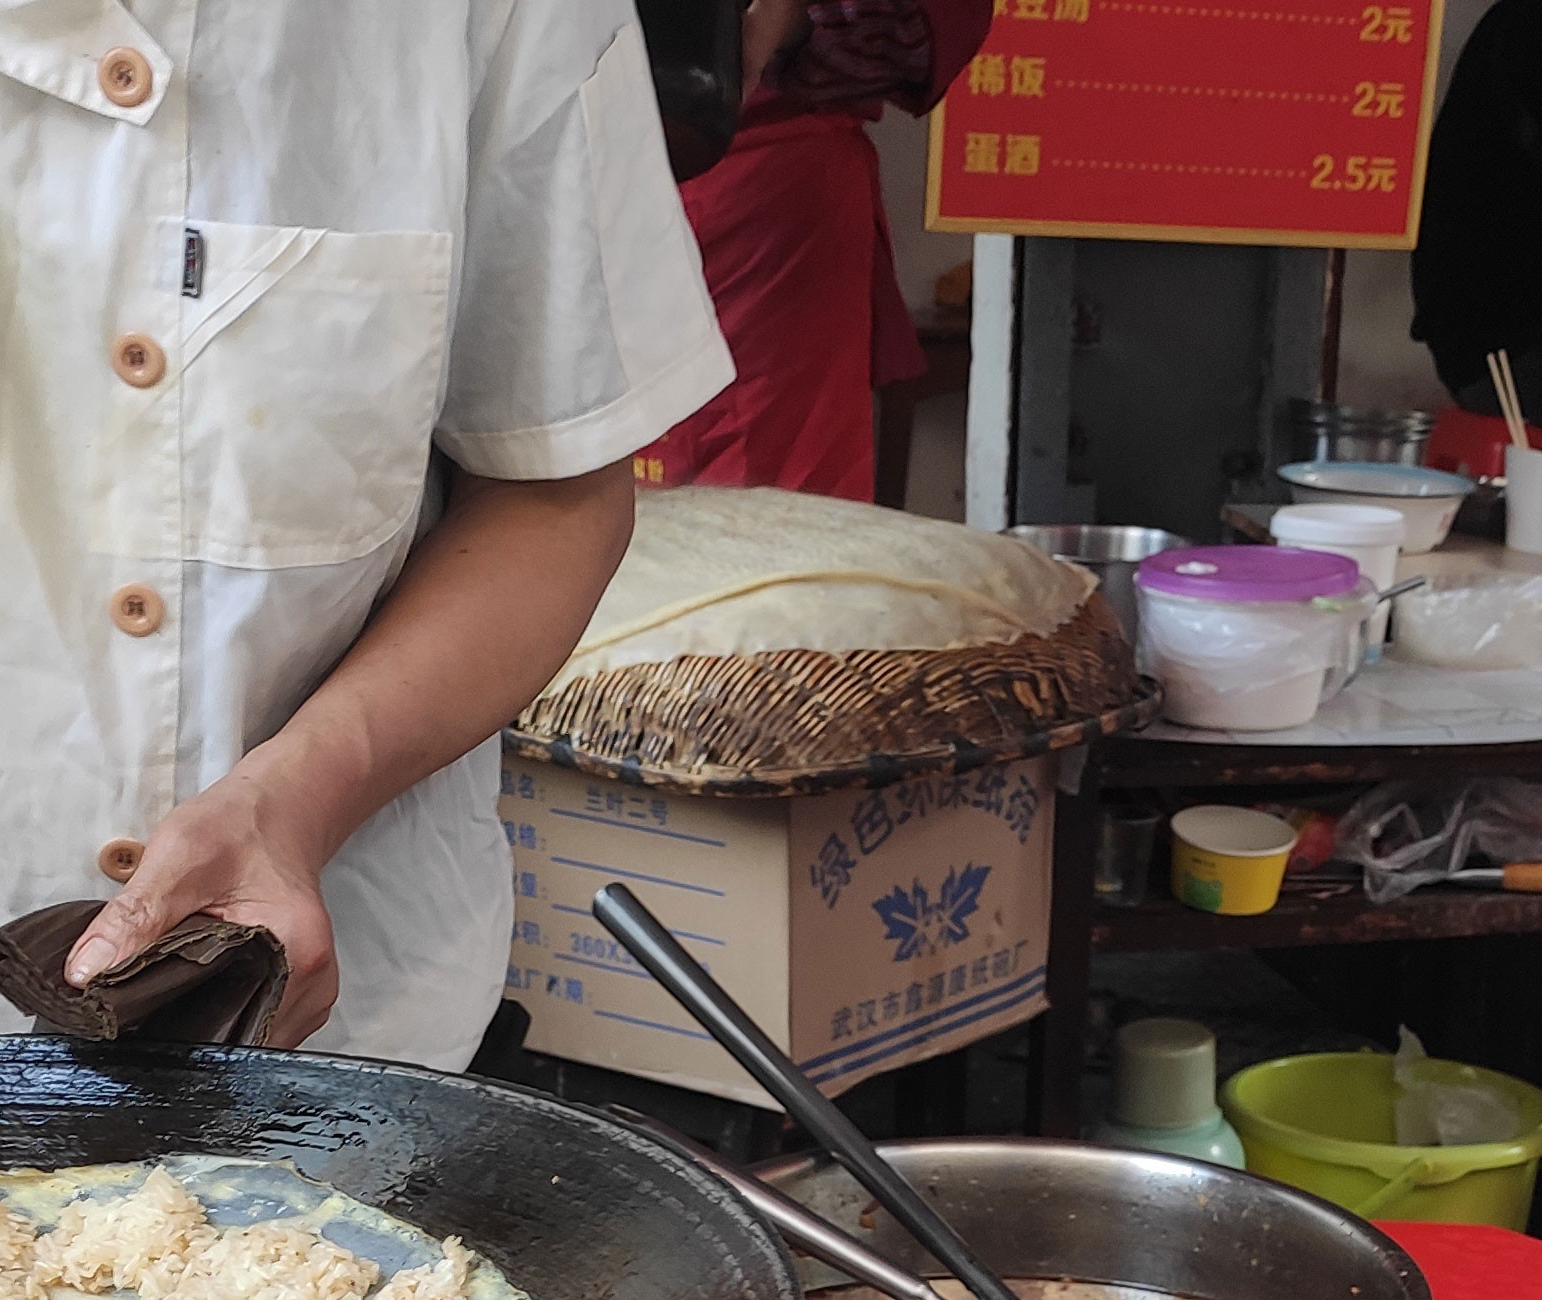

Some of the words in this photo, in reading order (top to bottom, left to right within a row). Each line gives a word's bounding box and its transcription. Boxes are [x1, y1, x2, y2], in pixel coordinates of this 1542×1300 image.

[1360, 5, 1413, 42] 2元
[969, 54, 1046, 97] 稀饭
[1352, 81, 1405, 118] 2元
[965, 131, 1041, 176] 蛋酒
[1310, 153, 1397, 192] 2.5元
